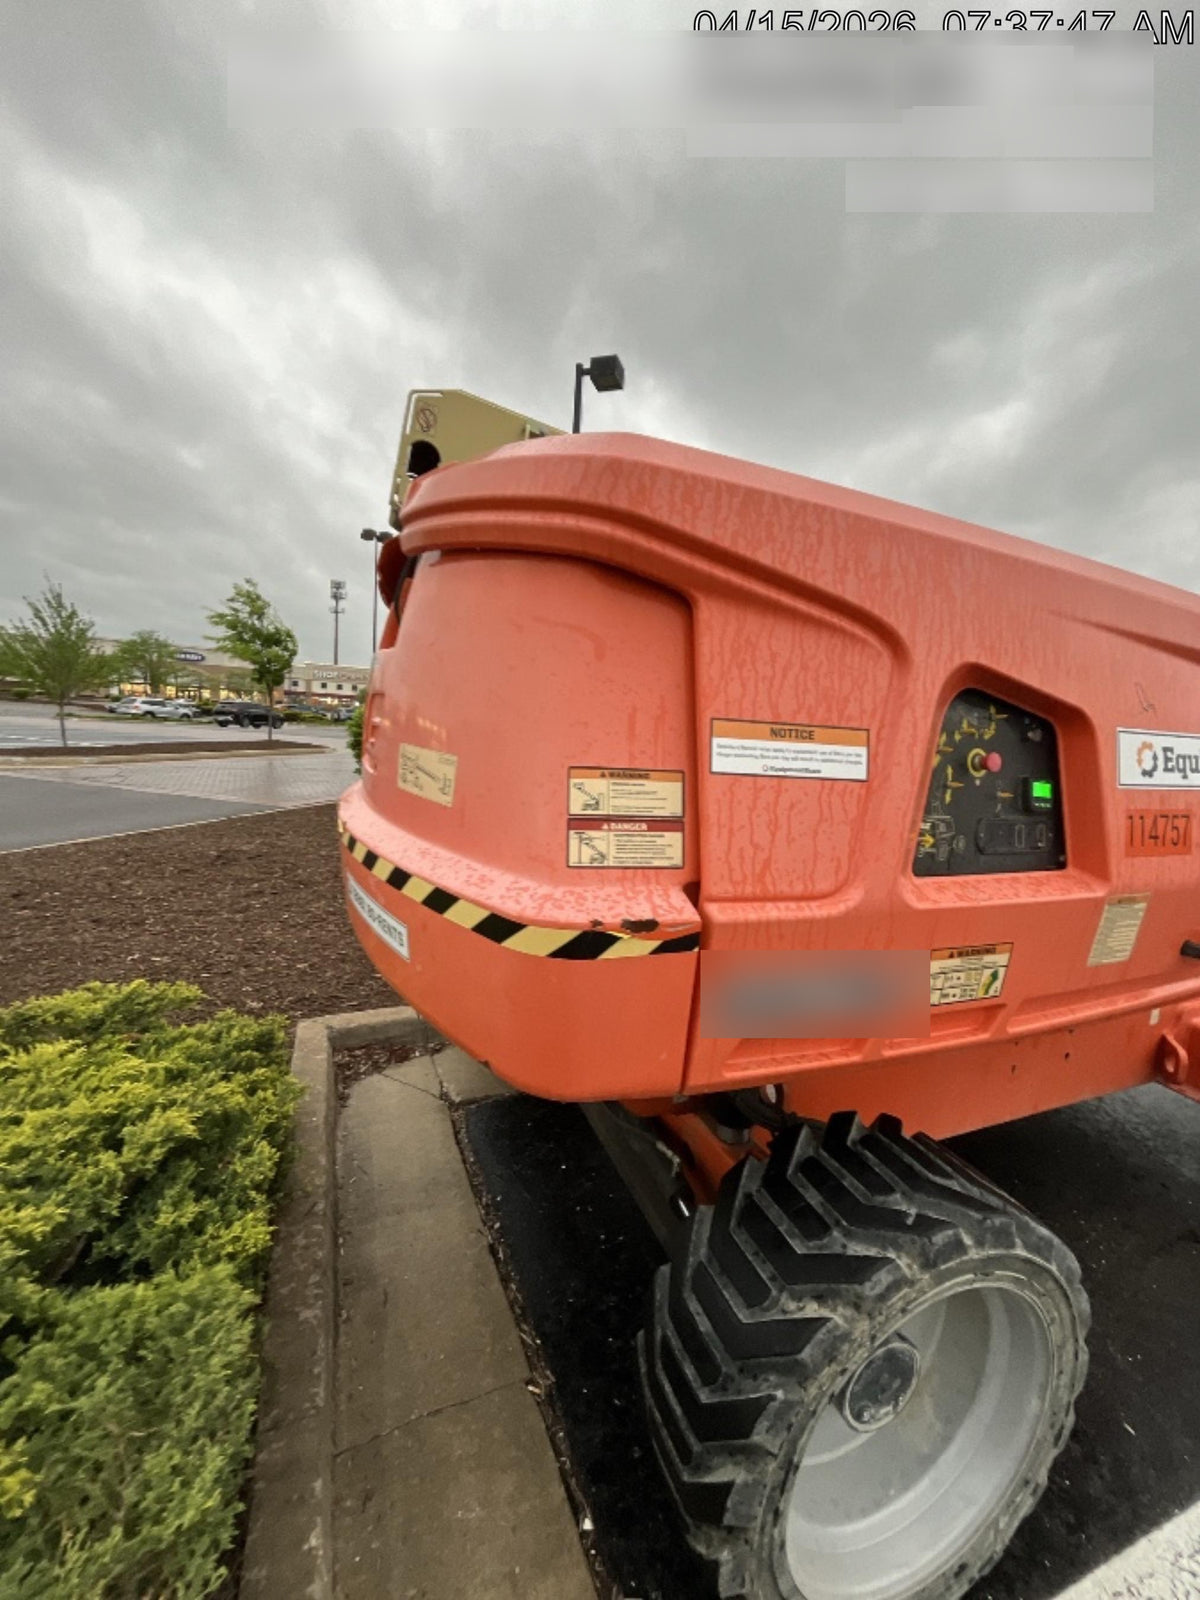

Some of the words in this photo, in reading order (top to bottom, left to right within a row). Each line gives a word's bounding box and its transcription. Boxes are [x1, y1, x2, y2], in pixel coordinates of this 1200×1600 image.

[770, 726, 816, 741] NOTICE
[1162, 746, 1200, 780] Equ
[607, 771, 651, 780] WARNING
[609, 821, 649, 832] DANGER
[1127, 813, 1191, 848] 114757
